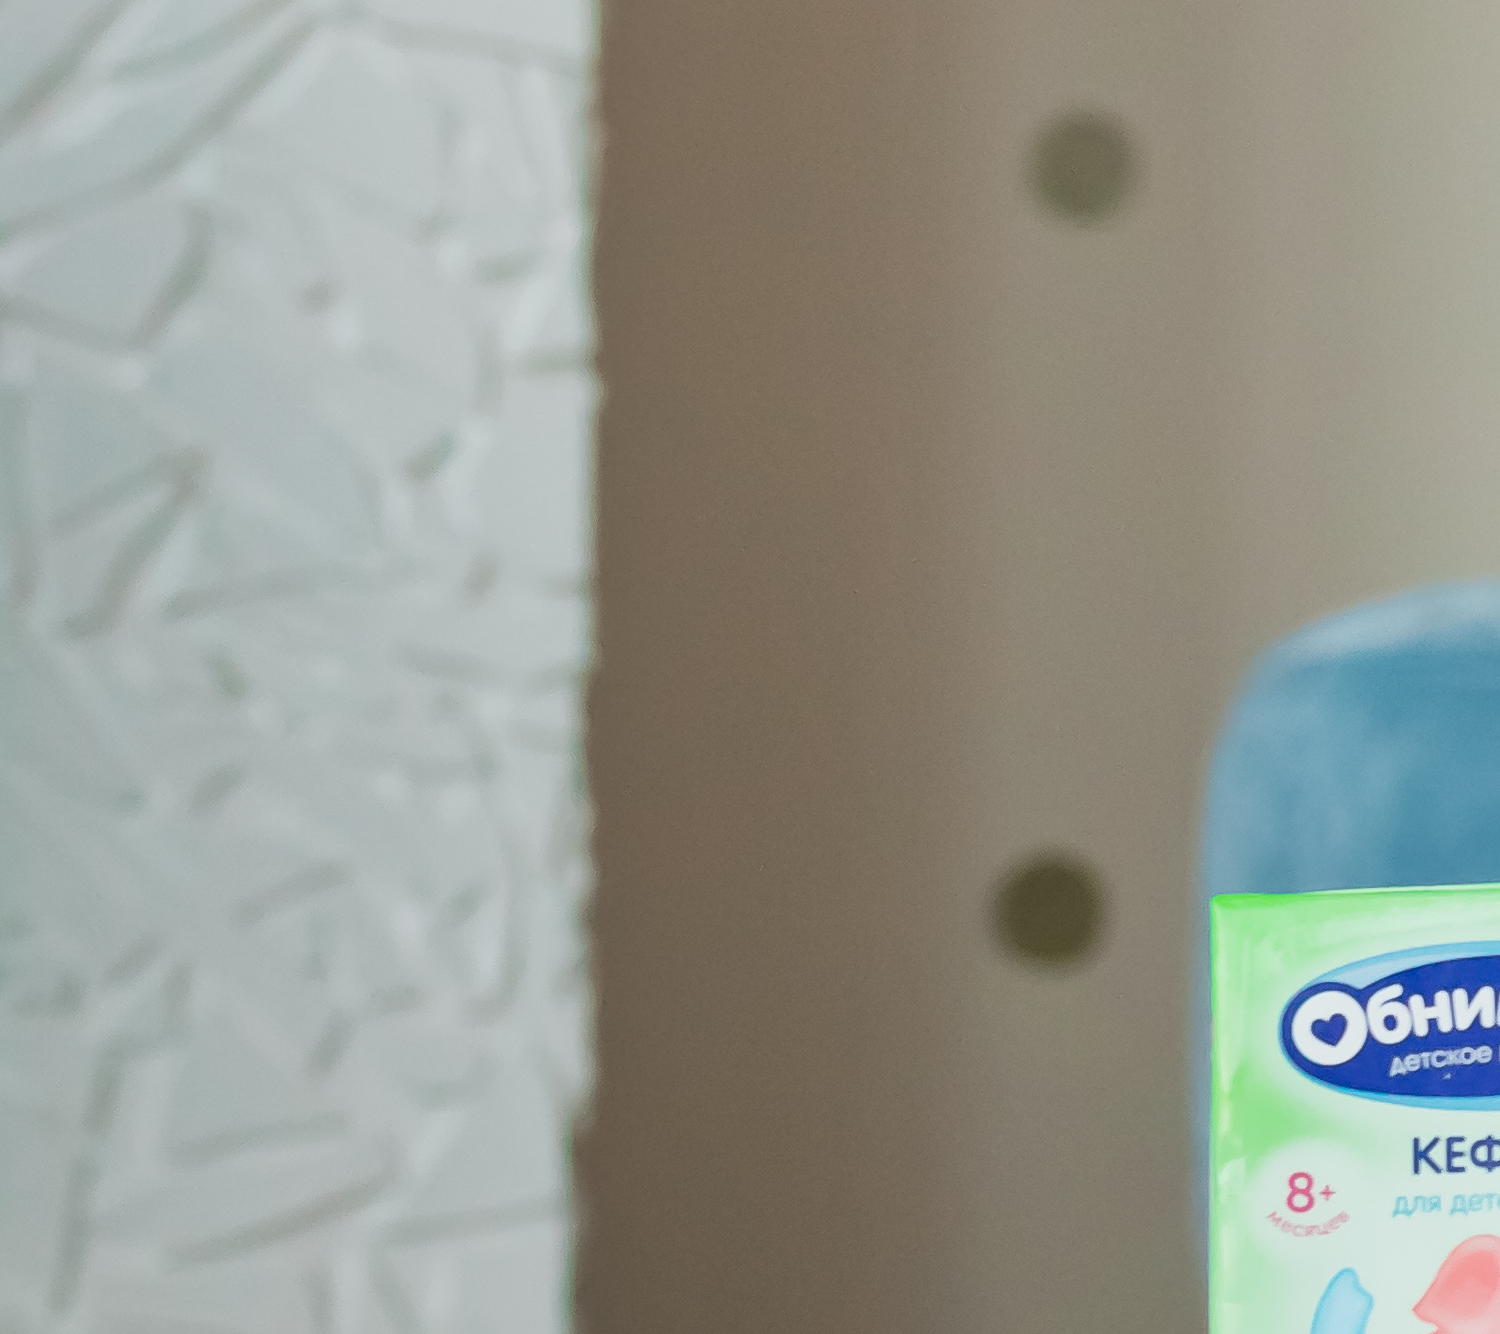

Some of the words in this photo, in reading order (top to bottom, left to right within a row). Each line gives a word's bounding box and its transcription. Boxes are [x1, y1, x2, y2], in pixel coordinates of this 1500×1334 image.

[1390, 1043, 1492, 1077] детское
[1286, 1172, 1336, 1214] 8+
[1392, 1193, 1442, 1219] для
